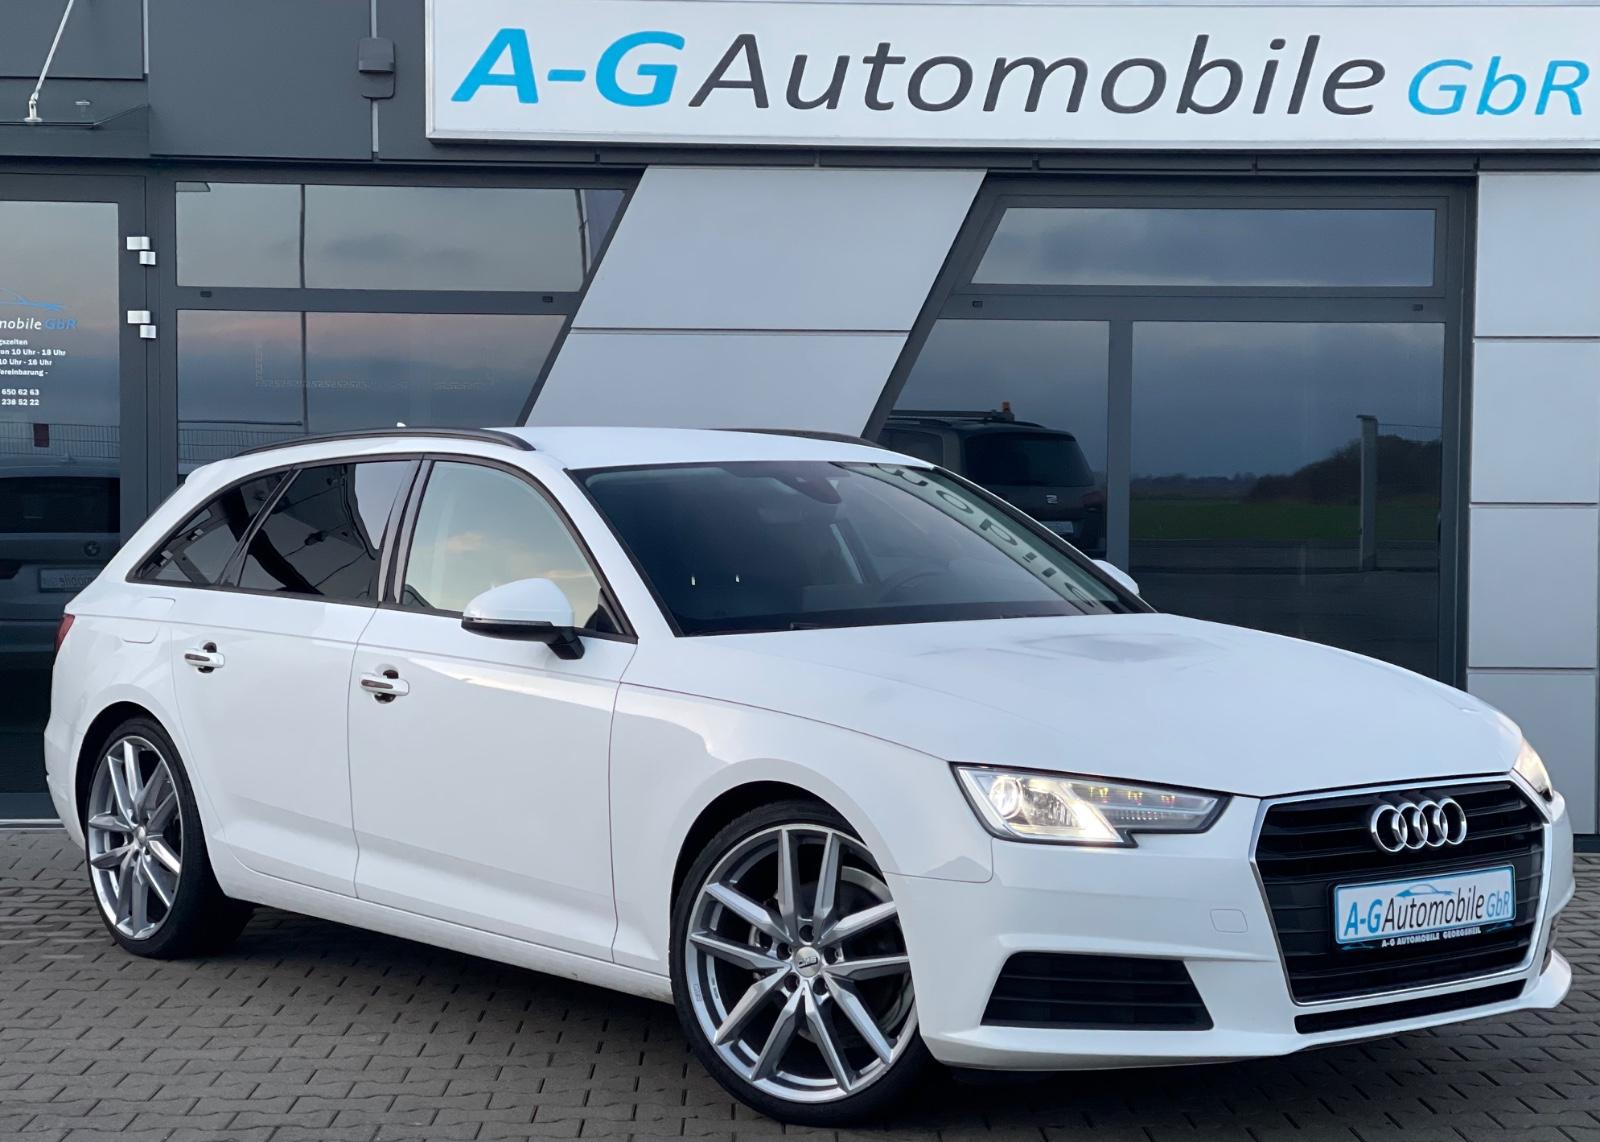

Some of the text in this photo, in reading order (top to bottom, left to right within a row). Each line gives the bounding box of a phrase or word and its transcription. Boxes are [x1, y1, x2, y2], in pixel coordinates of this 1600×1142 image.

[1408, 56, 1590, 116] GbR
[22, 348, 36, 356] Uhr
[1, 388, 17, 396] 650
[17, 388, 28, 396] 62
[1, 398, 40, 406] 238 52 22
[1487, 891, 1510, 917] GbR
[1396, 932, 1440, 946] AUTOMOBILE
